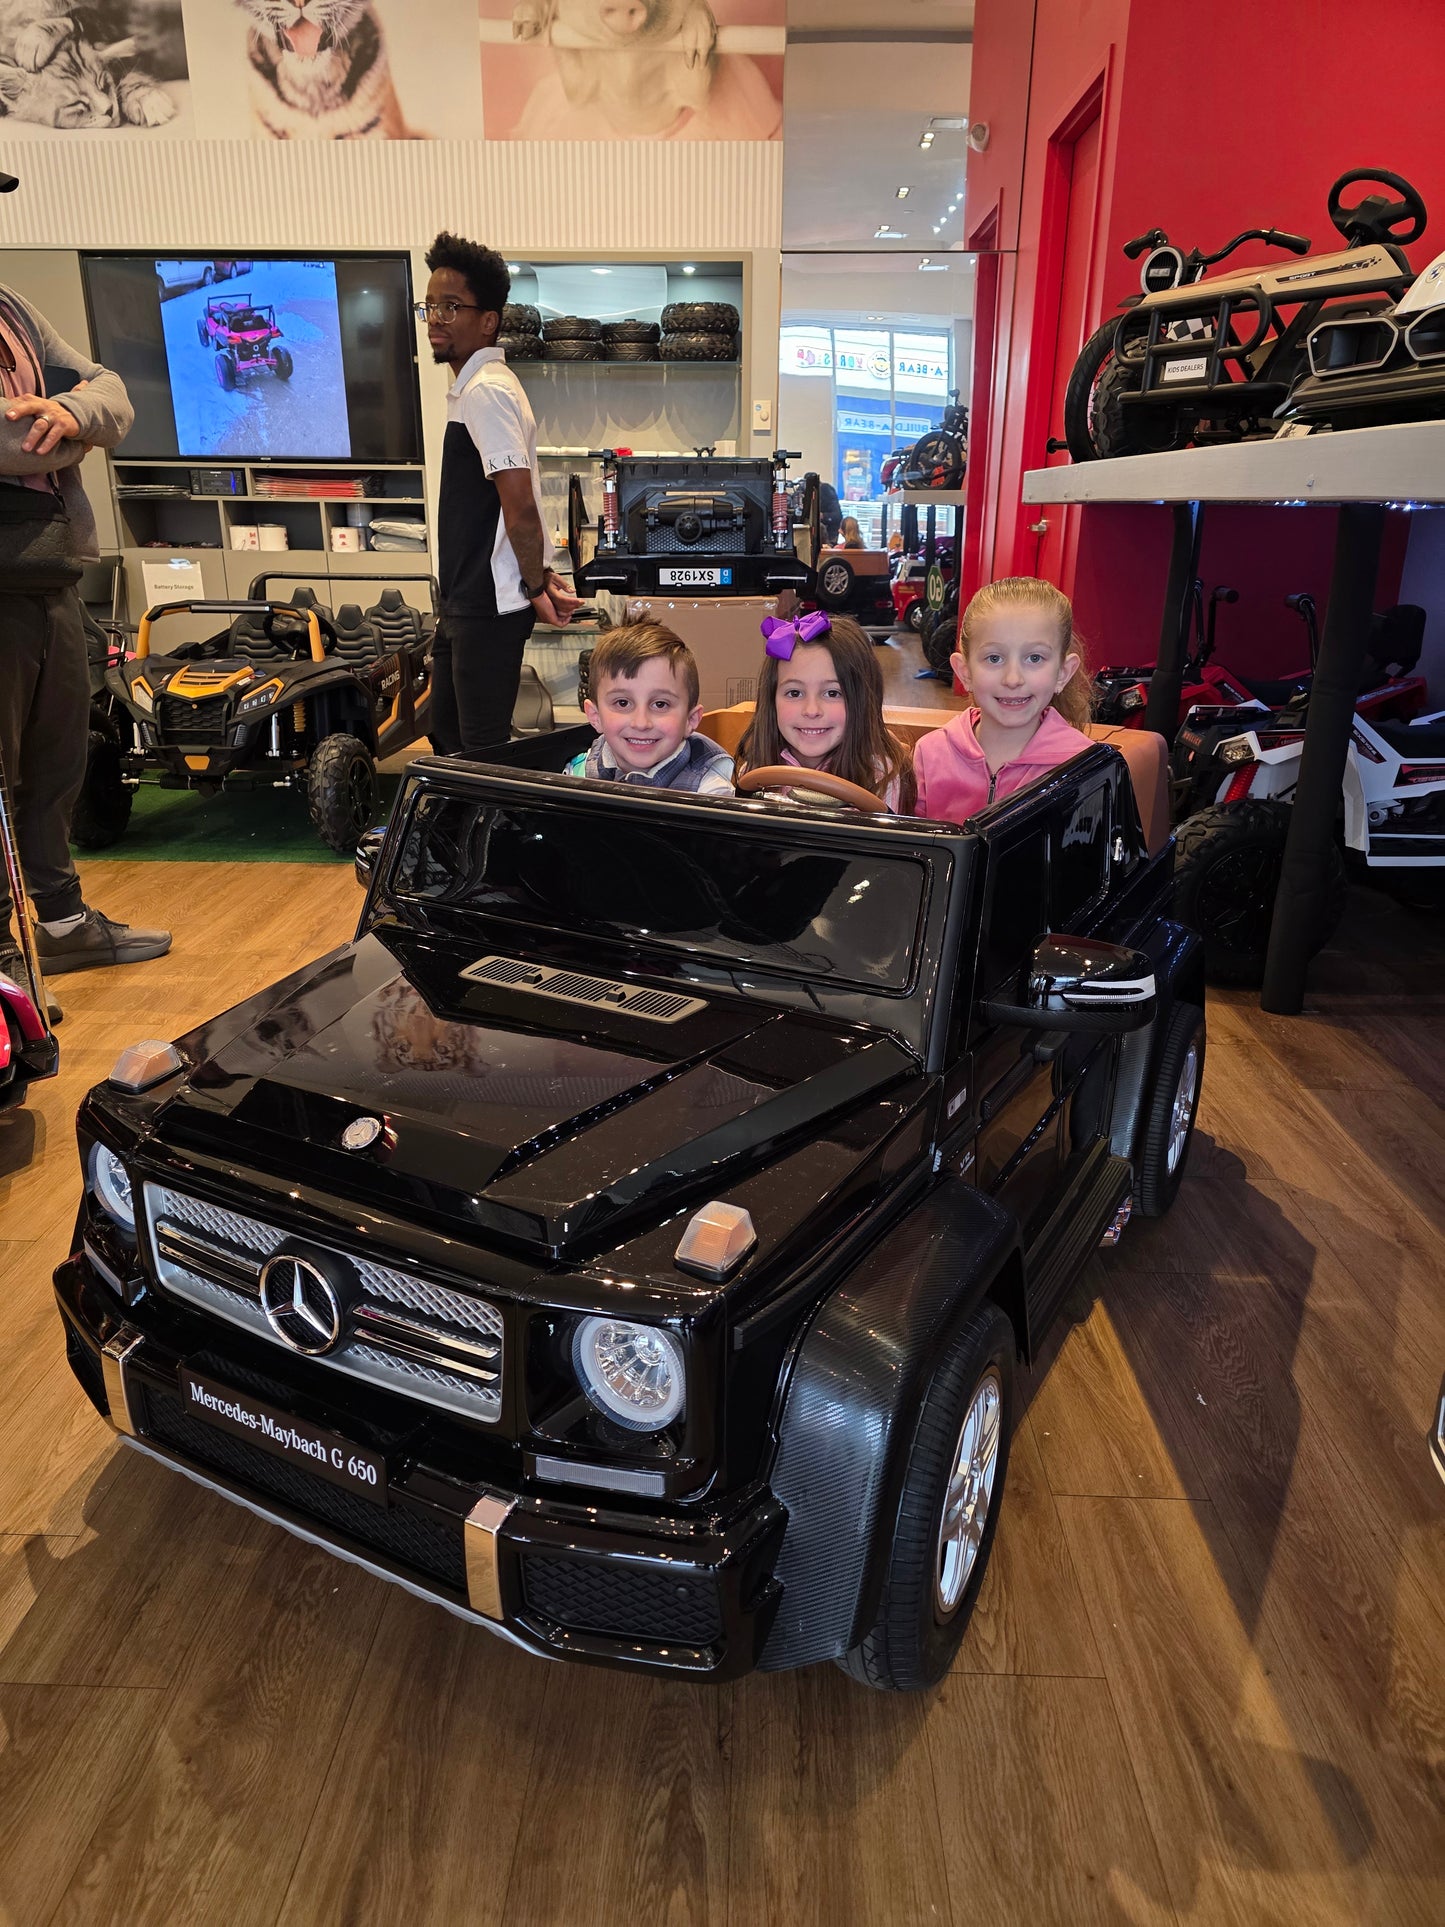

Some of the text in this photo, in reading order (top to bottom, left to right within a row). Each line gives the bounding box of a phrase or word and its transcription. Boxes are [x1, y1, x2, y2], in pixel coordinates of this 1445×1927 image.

[1167, 363, 1204, 374] KIDS DEALERS
[670, 570, 714, 581] SX1928
[381, 670, 400, 691] RACING
[189, 1381, 377, 1485] Mercedes-Maybach G 650
